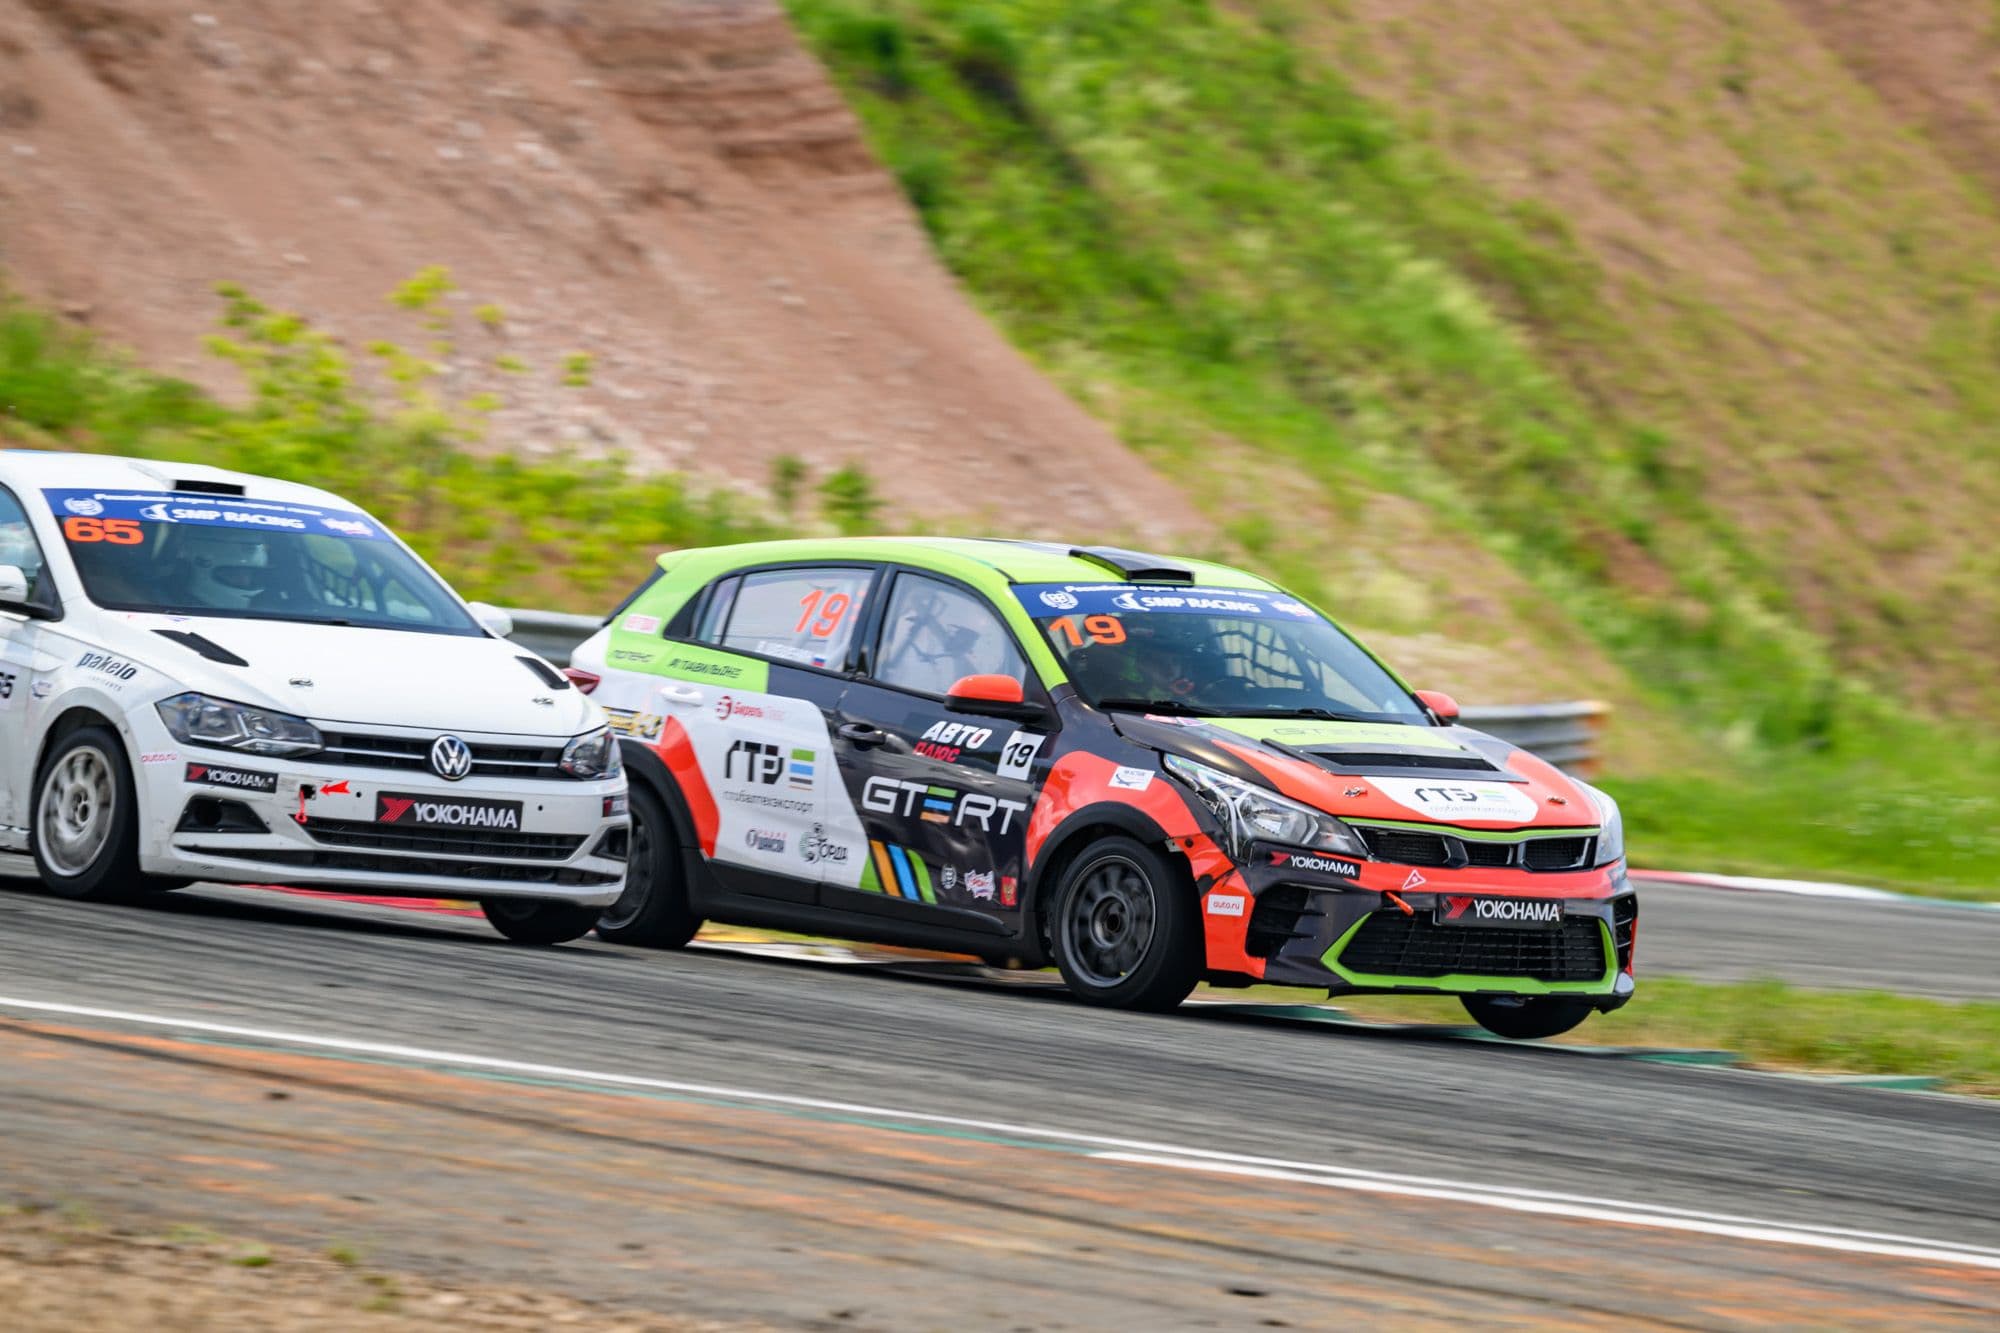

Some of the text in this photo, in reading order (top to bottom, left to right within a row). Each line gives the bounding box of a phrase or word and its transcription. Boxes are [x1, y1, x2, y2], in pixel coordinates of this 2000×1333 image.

[64, 516, 144, 546] 65
[171, 508, 222, 522] SMP
[223, 511, 307, 529] RACING
[795, 589, 851, 638] 19
[1139, 596, 1186, 609] SMP
[1187, 598, 1262, 614] RACING
[1049, 614, 1127, 648] 19
[75, 652, 138, 681] pakelo
[0, 671, 16, 699] 5
[920, 720, 993, 750] АВТО
[912, 742, 961, 763] ПЛЮС
[1005, 742, 1036, 768] 19
[413, 802, 518, 829] YOKOHAMA
[1290, 855, 1356, 876] YOKOHAMA
[1212, 901, 1241, 911] auto.ru
[1473, 899, 1561, 922] YOKOHAMA
